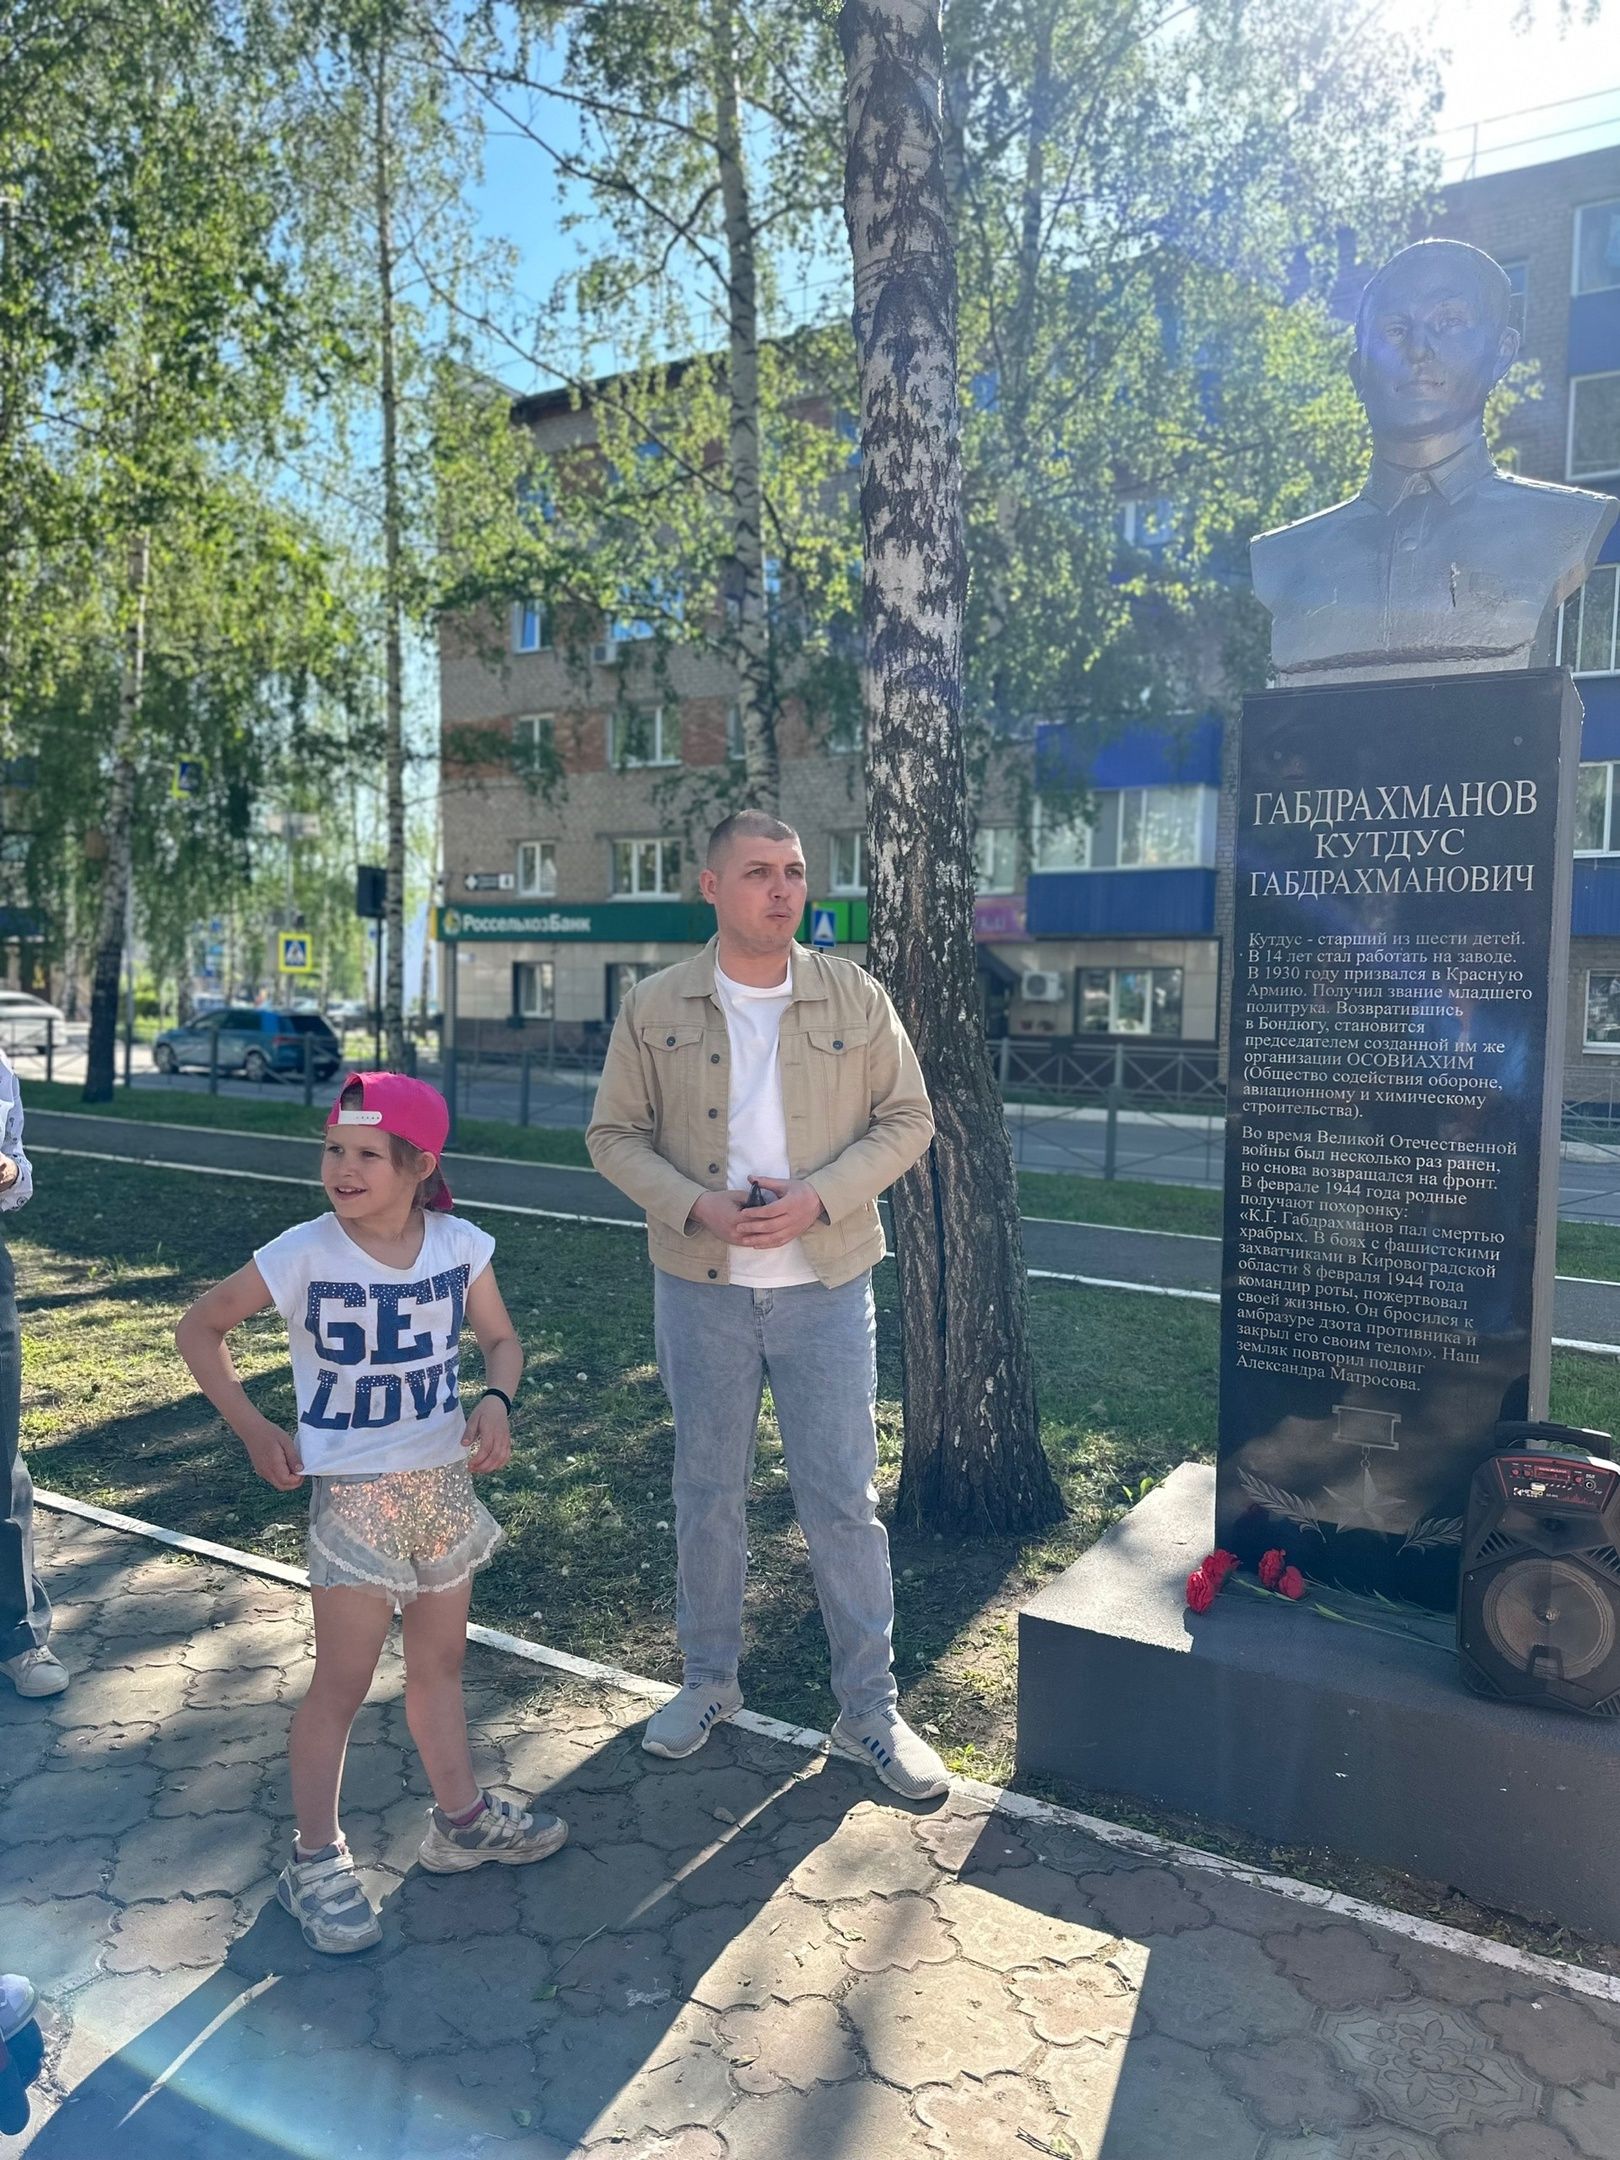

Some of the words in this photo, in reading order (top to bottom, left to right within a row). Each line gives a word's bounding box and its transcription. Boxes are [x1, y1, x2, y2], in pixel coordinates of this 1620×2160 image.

[1252, 779, 1538, 831] ГАБДРАХМАНОВ
[1314, 828, 1466, 863] КУТДУС
[1249, 864, 1535, 901] ГАБДРАХМАНОВИЧ
[1249, 932, 1302, 949] Кутдус
[1318, 932, 1387, 949] старший
[1393, 934, 1410, 945] из
[1416, 934, 1467, 945] шести
[1472, 931, 1525, 946] детей.
[1249, 949, 1260, 963] В
[1266, 949, 1282, 963] 14
[1287, 952, 1313, 963] лет
[1317, 952, 1351, 963] стал
[1356, 949, 1428, 966] работать
[1433, 952, 1452, 963] на
[1458, 952, 1517, 964] заводе.
[1248, 966, 1259, 980] В
[1265, 966, 1300, 980] 1930
[1305, 969, 1339, 983] году
[1344, 969, 1426, 984] призвался
[1432, 970, 1441, 980] в
[1446, 966, 1523, 985] Красную
[1247, 983, 1307, 1000] Армию.
[1313, 983, 1382, 1001] Получил
[1388, 987, 1442, 998] звание
[1448, 988, 1533, 1001] младшего
[1245, 1019, 1254, 1029] в
[1259, 1016, 1330, 1034] Бондюгу,
[1334, 1021, 1425, 1033] становится
[1246, 1002, 1330, 1017] политрука.
[1336, 1001, 1464, 1019] Возвратившись
[1245, 1035, 1359, 1050] председателем
[1364, 1038, 1448, 1052] созданной
[1454, 1042, 1477, 1053] им
[1482, 1042, 1506, 1053] же
[1244, 1052, 1342, 1066] организации
[1347, 1052, 1474, 1070] ОСОВИАХИМ
[1244, 1066, 1328, 1081] (Общество
[1332, 1071, 1423, 1086] содействия
[1428, 1073, 1503, 1092] обороне,
[1242, 1102, 1363, 1120] строительства).
[1243, 1085, 1355, 1104] авиационному
[1360, 1091, 1370, 1101] и
[1375, 1091, 1487, 1110] химическому
[1242, 1126, 1262, 1140] Во
[1267, 1130, 1312, 1144] время
[1317, 1130, 1385, 1147] Великой
[1390, 1134, 1518, 1155] Отечественной
[1242, 1144, 1290, 1158] войны
[1295, 1146, 1325, 1160] был
[1330, 1150, 1411, 1166] несколько
[1416, 1156, 1442, 1170] раз
[1447, 1158, 1501, 1174] ранен,
[1241, 1175, 1252, 1189] В
[1257, 1176, 1319, 1195] феврале
[1326, 1182, 1361, 1197] 1944
[1366, 1187, 1401, 1200] года
[1406, 1191, 1468, 1205] родные
[1242, 1162, 1259, 1172] но
[1264, 1164, 1307, 1176] снова
[1312, 1166, 1413, 1183] возвращался
[1419, 1175, 1438, 1186] на
[1443, 1173, 1498, 1190] фронт.
[1240, 1194, 1315, 1209] получают
[1320, 1202, 1408, 1220] похоронку:
[1282, 1211, 1394, 1234] Габдрахманов
[1399, 1225, 1427, 1236] пал
[1432, 1227, 1505, 1244] смертью
[1239, 1226, 1308, 1243] храбрых.
[1314, 1231, 1325, 1244] В
[1330, 1232, 1366, 1248] боях
[1371, 1240, 1380, 1249] с
[1384, 1237, 1500, 1261] фашистскими
[1238, 1258, 1298, 1274] области
[1302, 1263, 1311, 1276] 8
[1316, 1265, 1381, 1284] февраля
[1388, 1272, 1424, 1288] 1944
[1429, 1279, 1464, 1293] года
[1239, 1243, 1343, 1263] захватчиками
[1348, 1253, 1356, 1264] в
[1362, 1252, 1496, 1278] Кировоградской
[1238, 1276, 1311, 1295] командир
[1315, 1284, 1358, 1299] роты,
[1363, 1289, 1468, 1310] пожертвовал
[305, 1263, 471, 1366] GET
[1237, 1291, 1280, 1306] своей
[1285, 1297, 1350, 1314] жизнью.
[1355, 1302, 1378, 1318] Он
[1383, 1305, 1459, 1327] бросился
[1464, 1318, 1475, 1329] к
[1237, 1307, 1315, 1328] амбразуре
[1319, 1318, 1361, 1333] дзота
[1366, 1323, 1461, 1344] противника
[1466, 1335, 1476, 1346] и
[1236, 1340, 1288, 1357] земляк
[1292, 1347, 1365, 1368] повторил
[1369, 1357, 1425, 1374] подвиг
[1237, 1324, 1289, 1341] закрыл
[1294, 1331, 1318, 1344] его
[1322, 1335, 1370, 1351] своим
[1375, 1341, 1437, 1359] телом».
[1442, 1347, 1480, 1364] Наш
[1236, 1354, 1326, 1380] Александра
[1330, 1366, 1421, 1391] Матросова.
